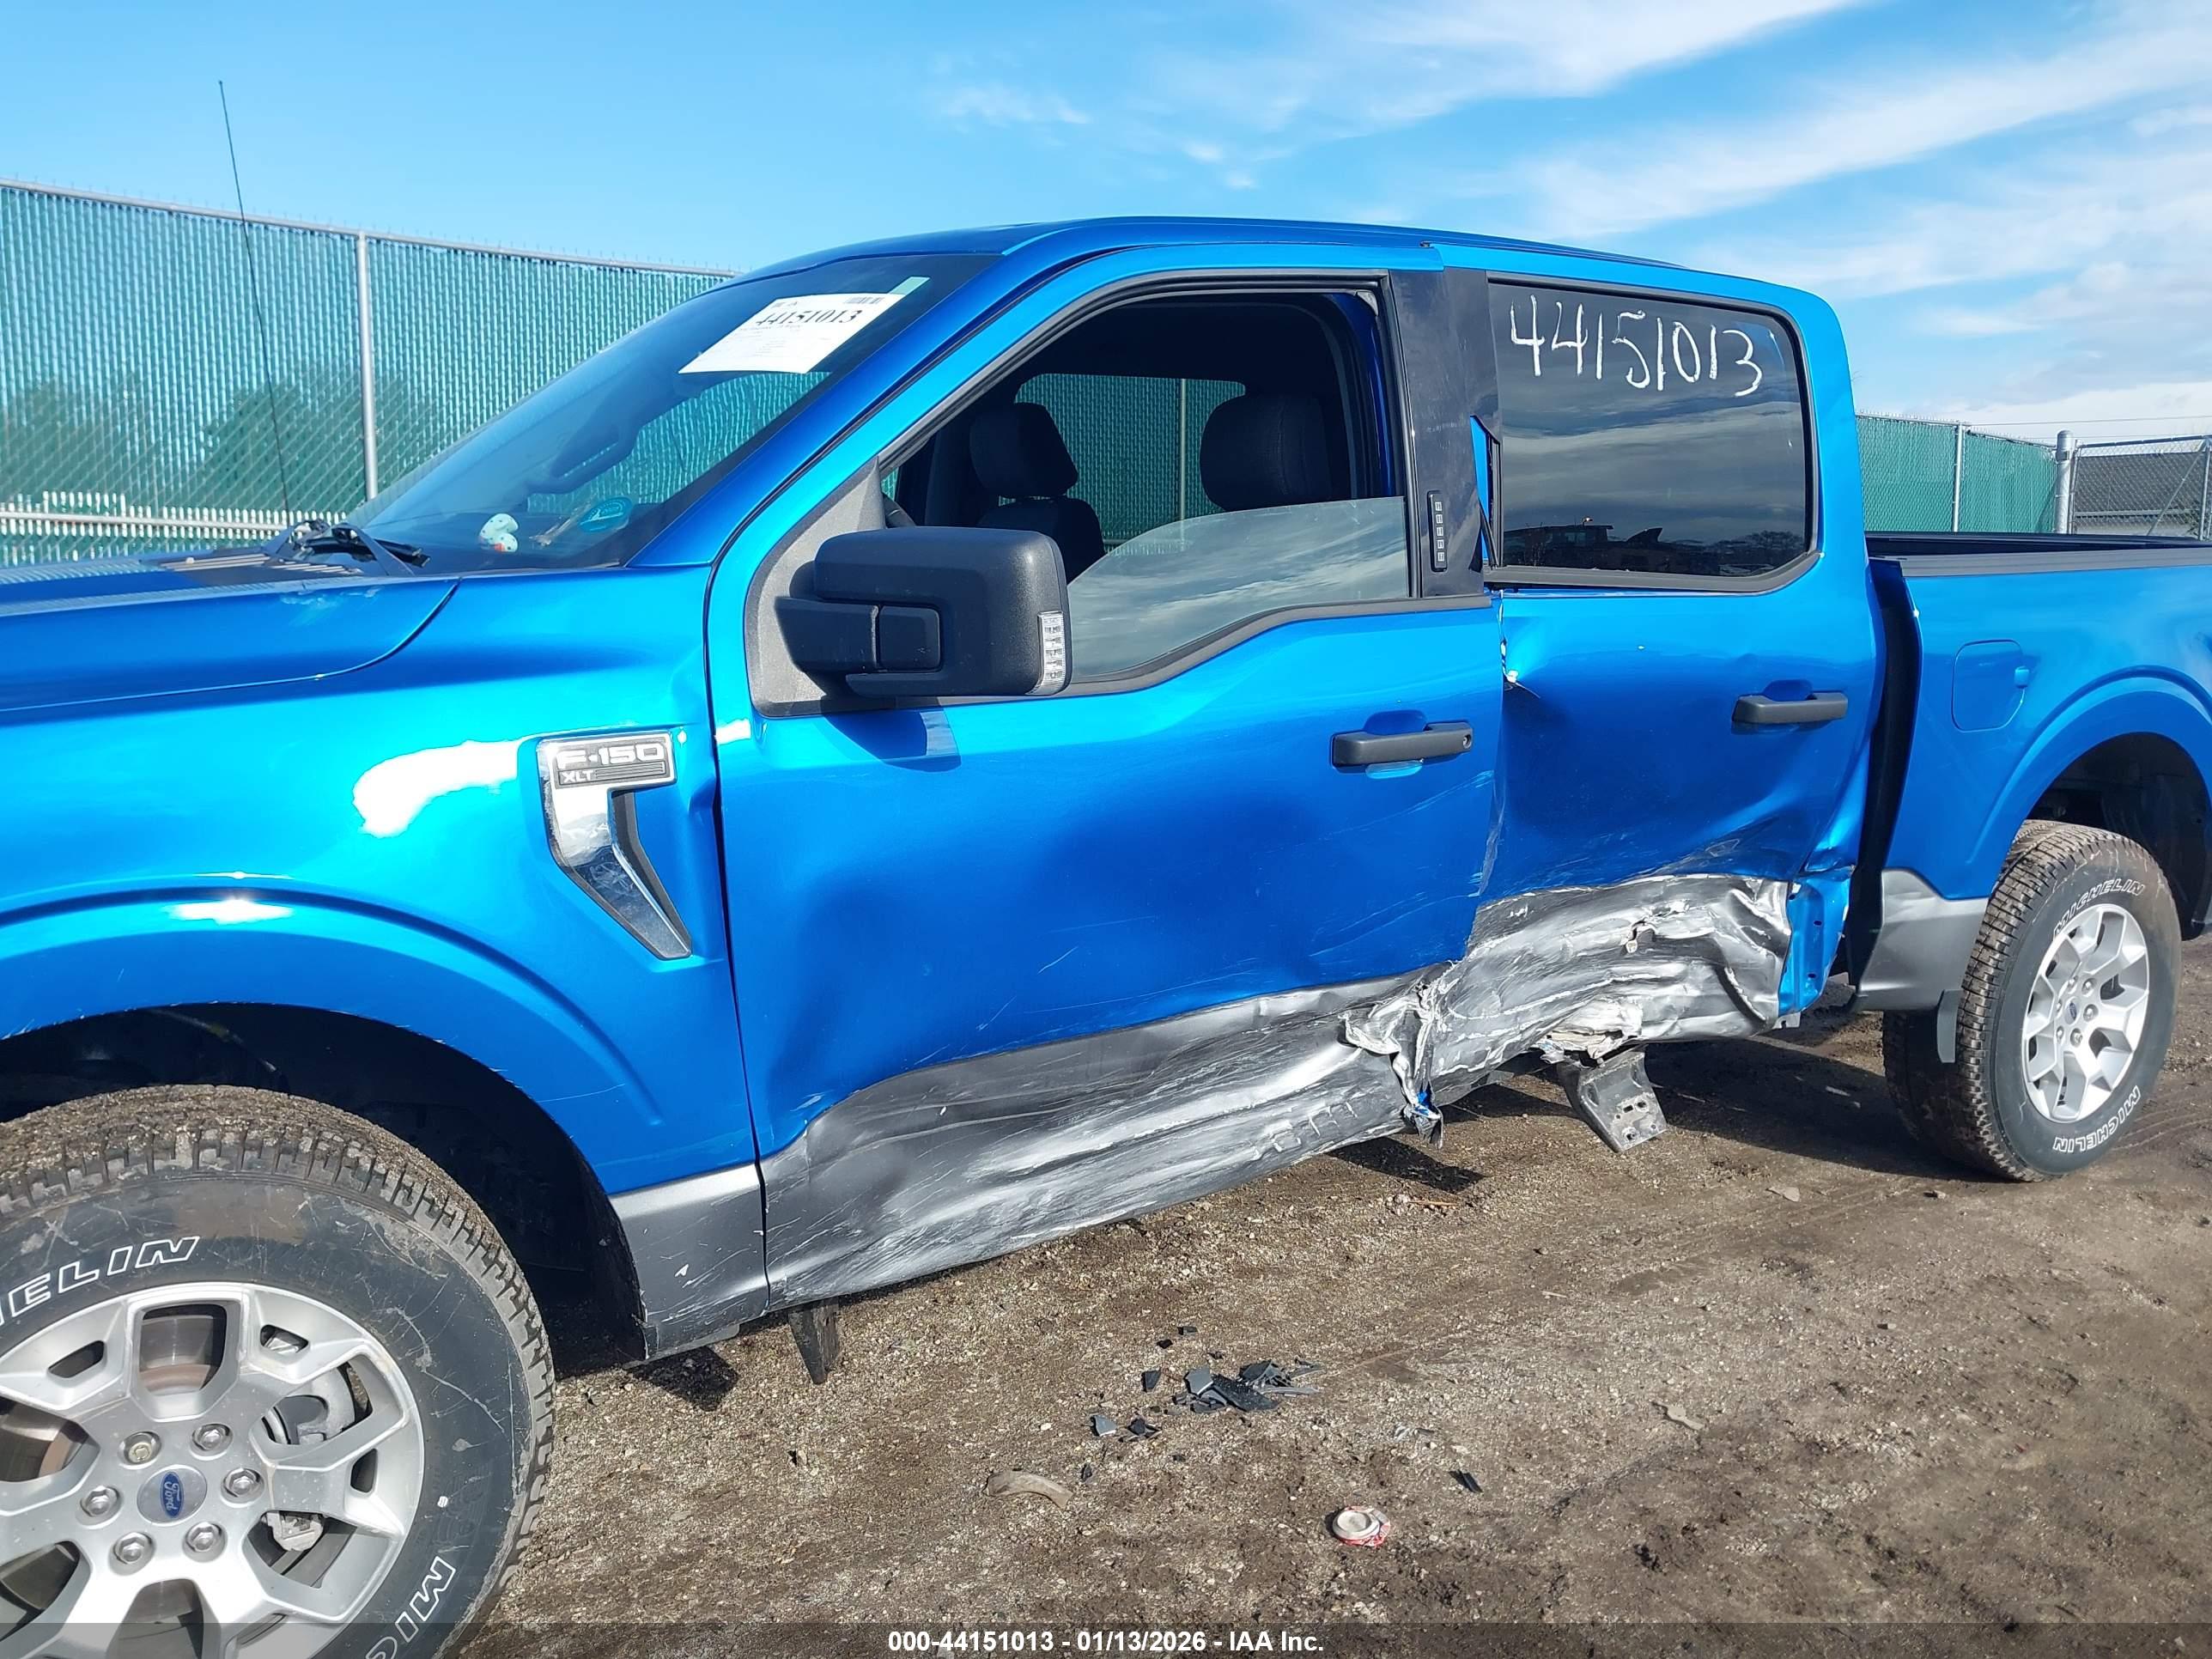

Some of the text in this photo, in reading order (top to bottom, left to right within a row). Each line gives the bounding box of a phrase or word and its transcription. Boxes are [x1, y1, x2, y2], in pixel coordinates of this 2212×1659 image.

[755, 309, 863, 326] 44151013
[1510, 294, 1762, 397] 44151013
[556, 742, 665, 770] F-150
[562, 769, 596, 784] XLT
[2052, 878, 2146, 942] MICHELIN
[2051, 1085, 2142, 1153] MICHELIN
[0, 1236, 201, 1327] ELIN
[163, 1481, 180, 1511] Ford
